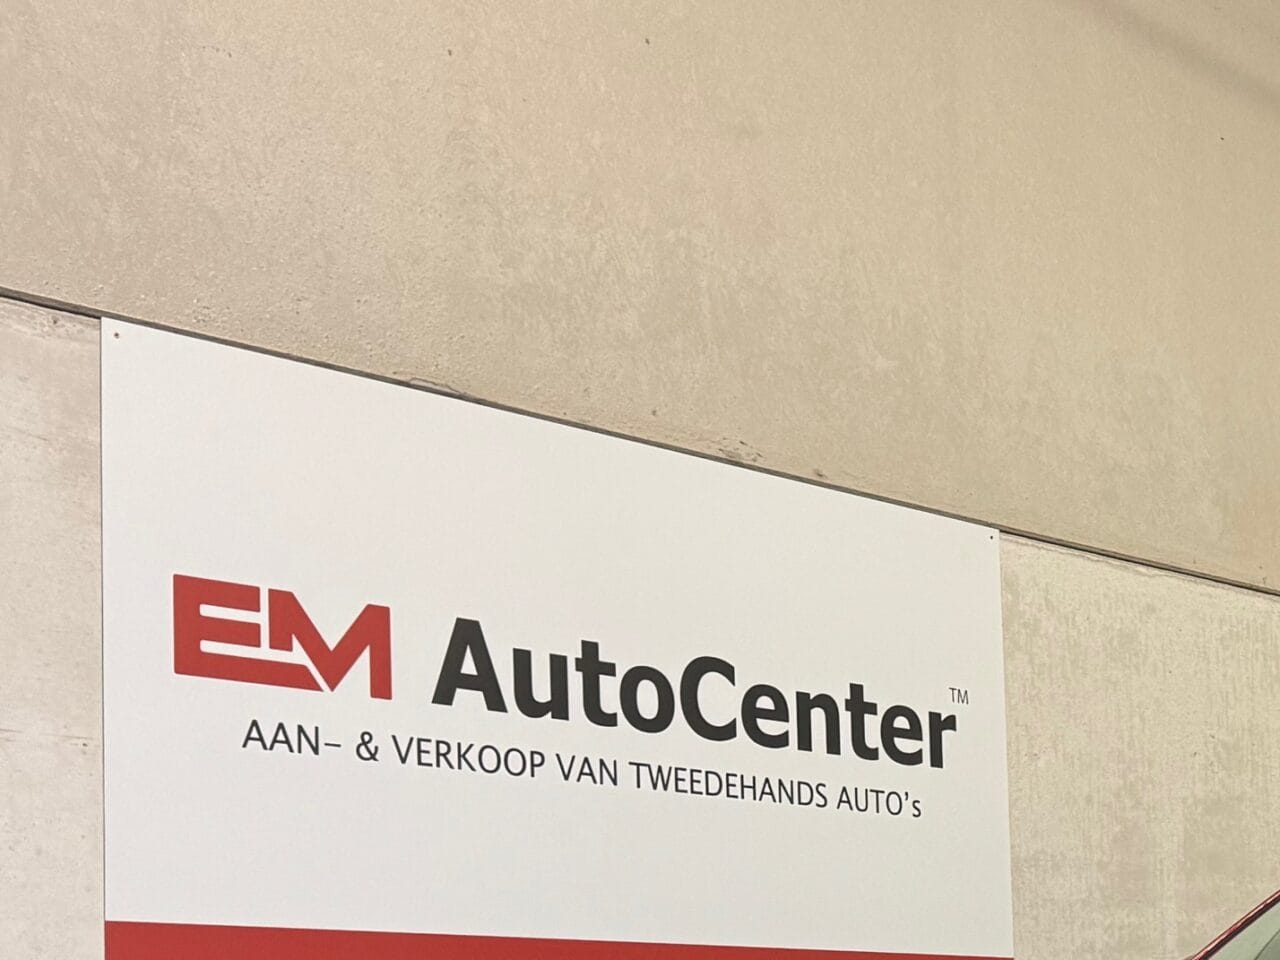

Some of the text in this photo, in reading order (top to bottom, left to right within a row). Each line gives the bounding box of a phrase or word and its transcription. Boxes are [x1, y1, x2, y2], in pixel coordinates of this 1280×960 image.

[173, 574, 393, 700] EM
[431, 617, 958, 770] AutoCenter
[355, 731, 380, 763] &
[391, 734, 545, 778] VERKOOP
[555, 753, 618, 786] VAN
[628, 761, 828, 809] TWEEDEHANDS
